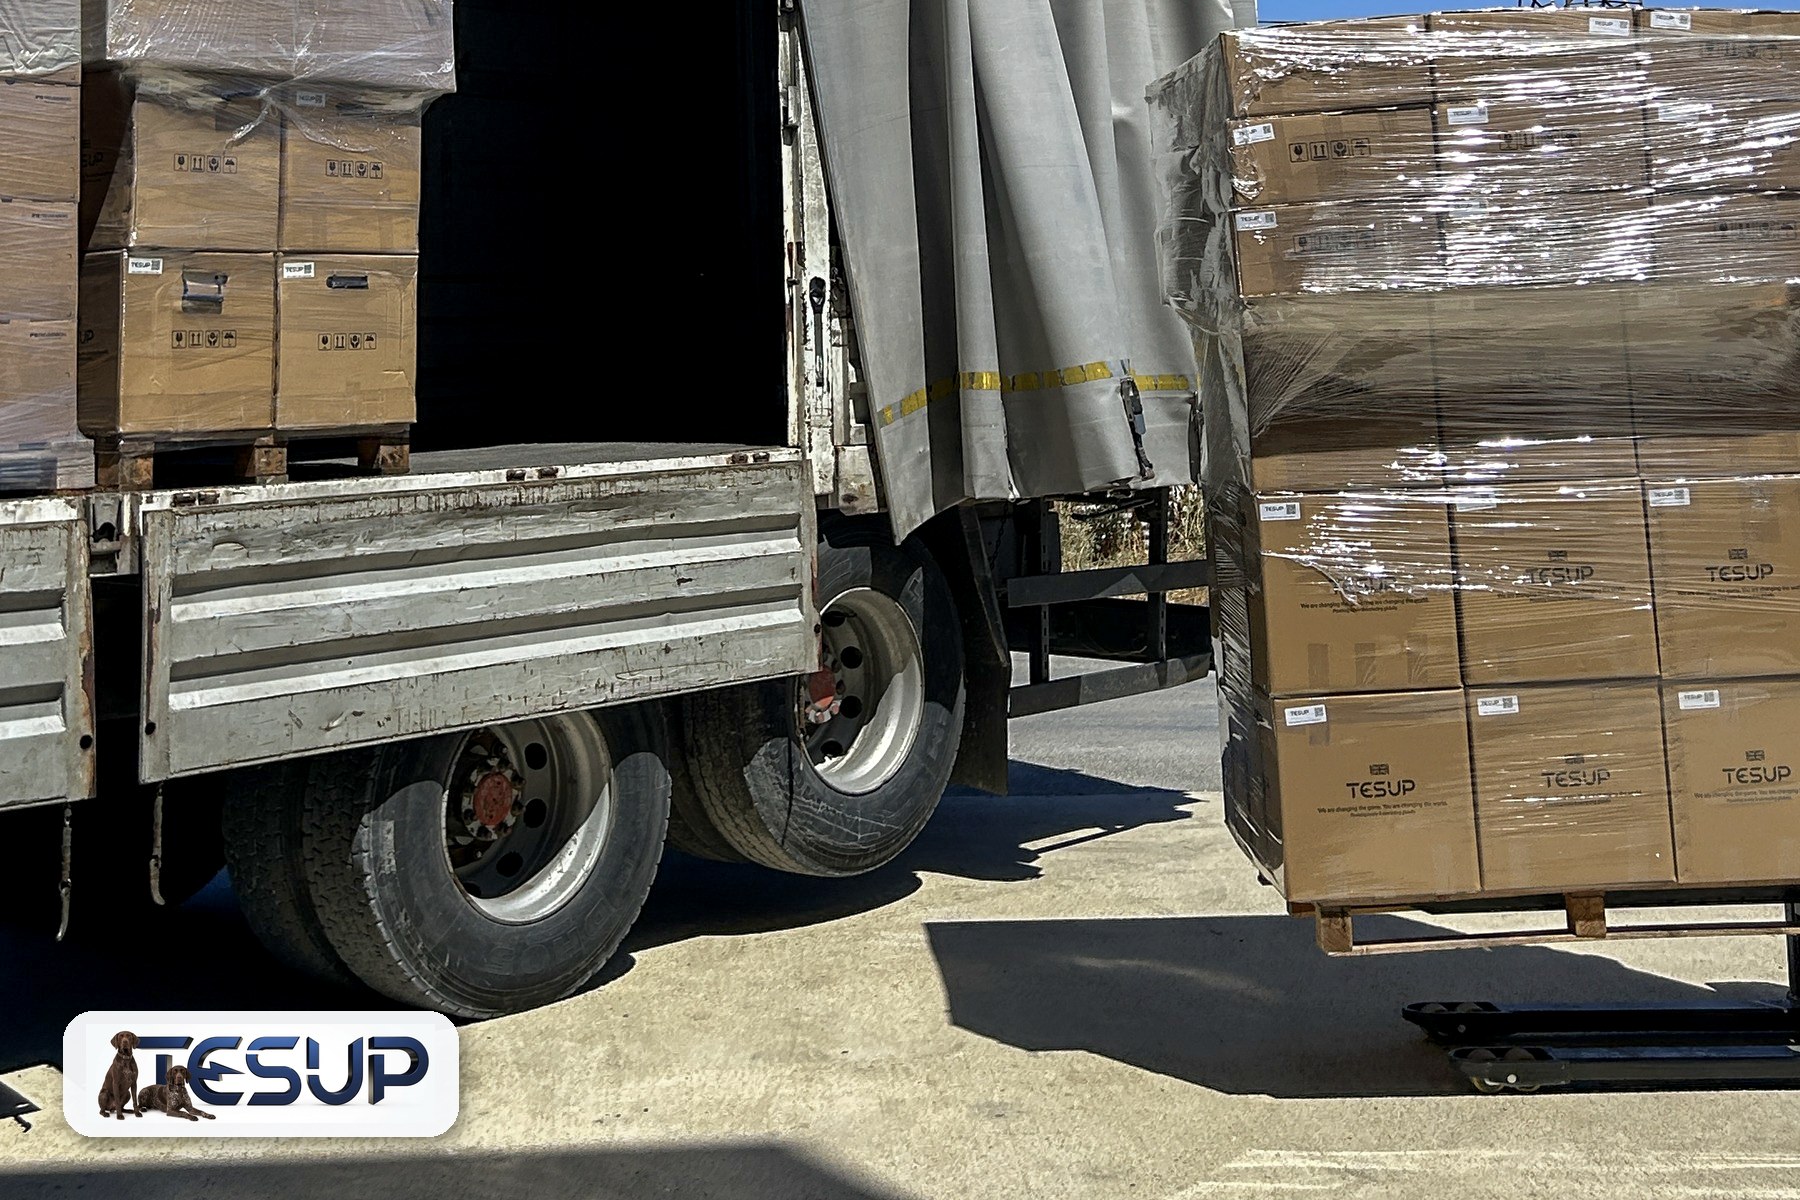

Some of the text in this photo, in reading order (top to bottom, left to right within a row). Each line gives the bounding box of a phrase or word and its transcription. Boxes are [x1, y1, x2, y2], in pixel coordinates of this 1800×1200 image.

[1525, 565, 1595, 584] TESUP
[1705, 563, 1774, 582] TESUP
[1541, 768, 1611, 788] TESUP
[1721, 765, 1792, 784] TESUP
[1345, 779, 1416, 799] TESUP
